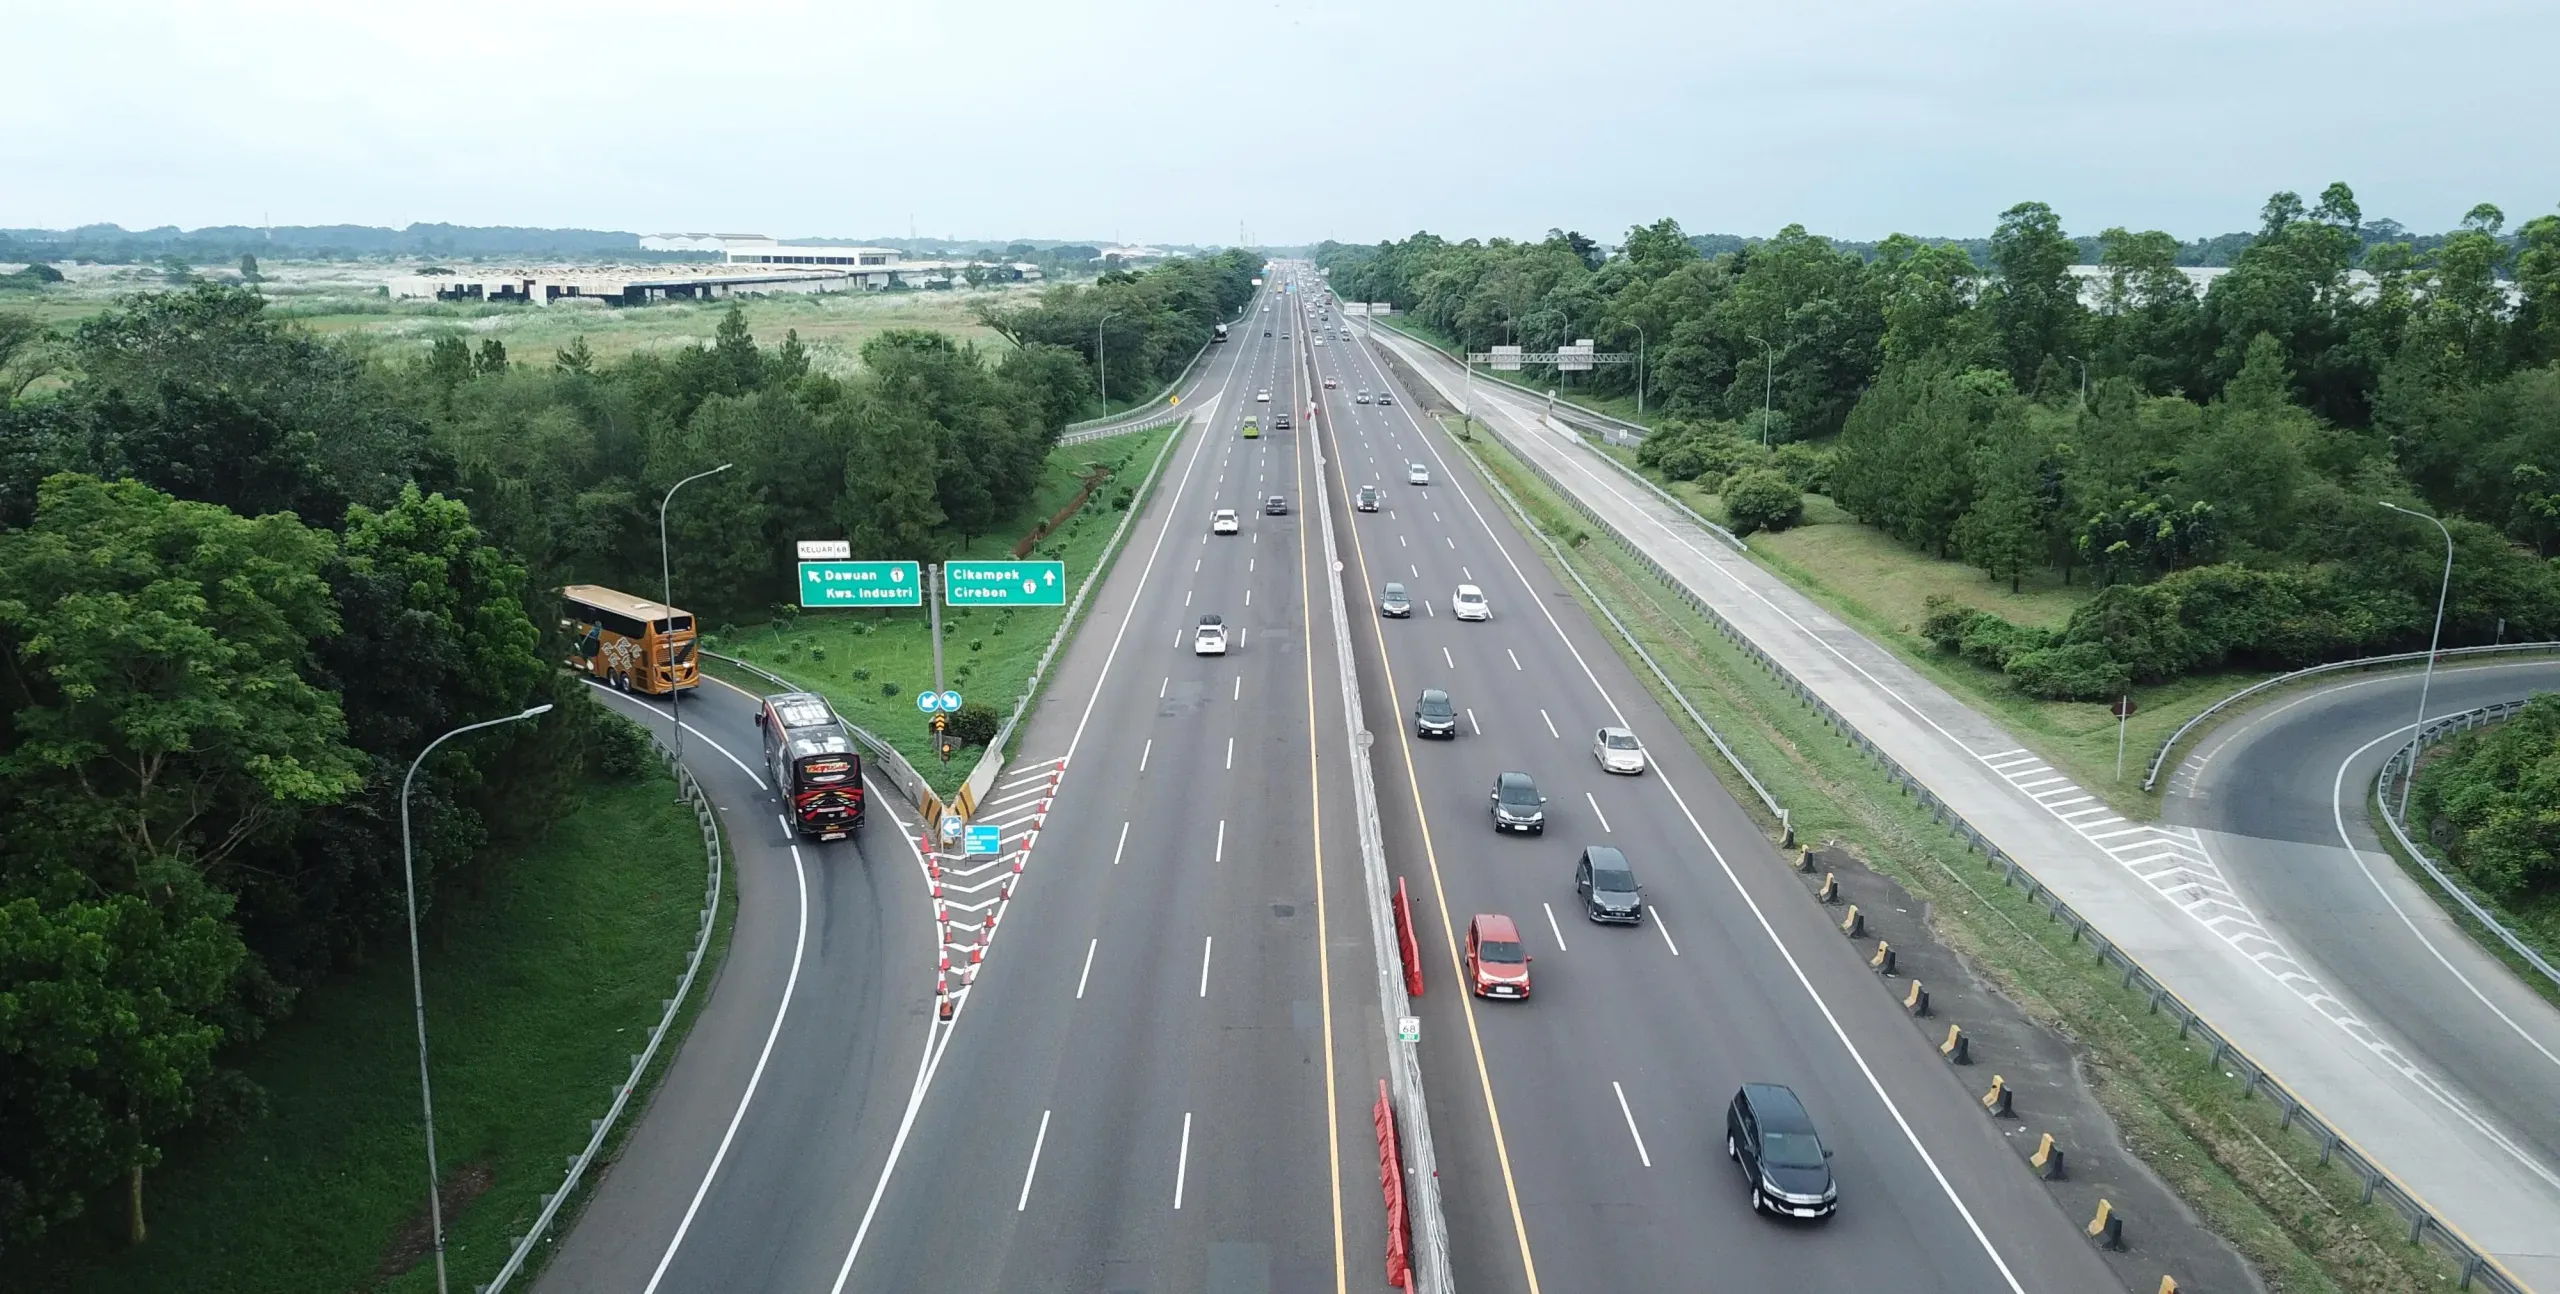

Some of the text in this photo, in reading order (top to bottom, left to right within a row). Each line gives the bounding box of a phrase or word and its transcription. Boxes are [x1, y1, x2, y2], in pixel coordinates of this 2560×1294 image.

[800, 544, 847, 553] KELUAR 68
[825, 570, 877, 581] Dawuan
[953, 569, 1020, 582] Cikampek
[826, 587, 912, 599] Kws. Industri
[954, 587, 1007, 598] Cirebon
[1402, 1025, 1416, 1033] 68
